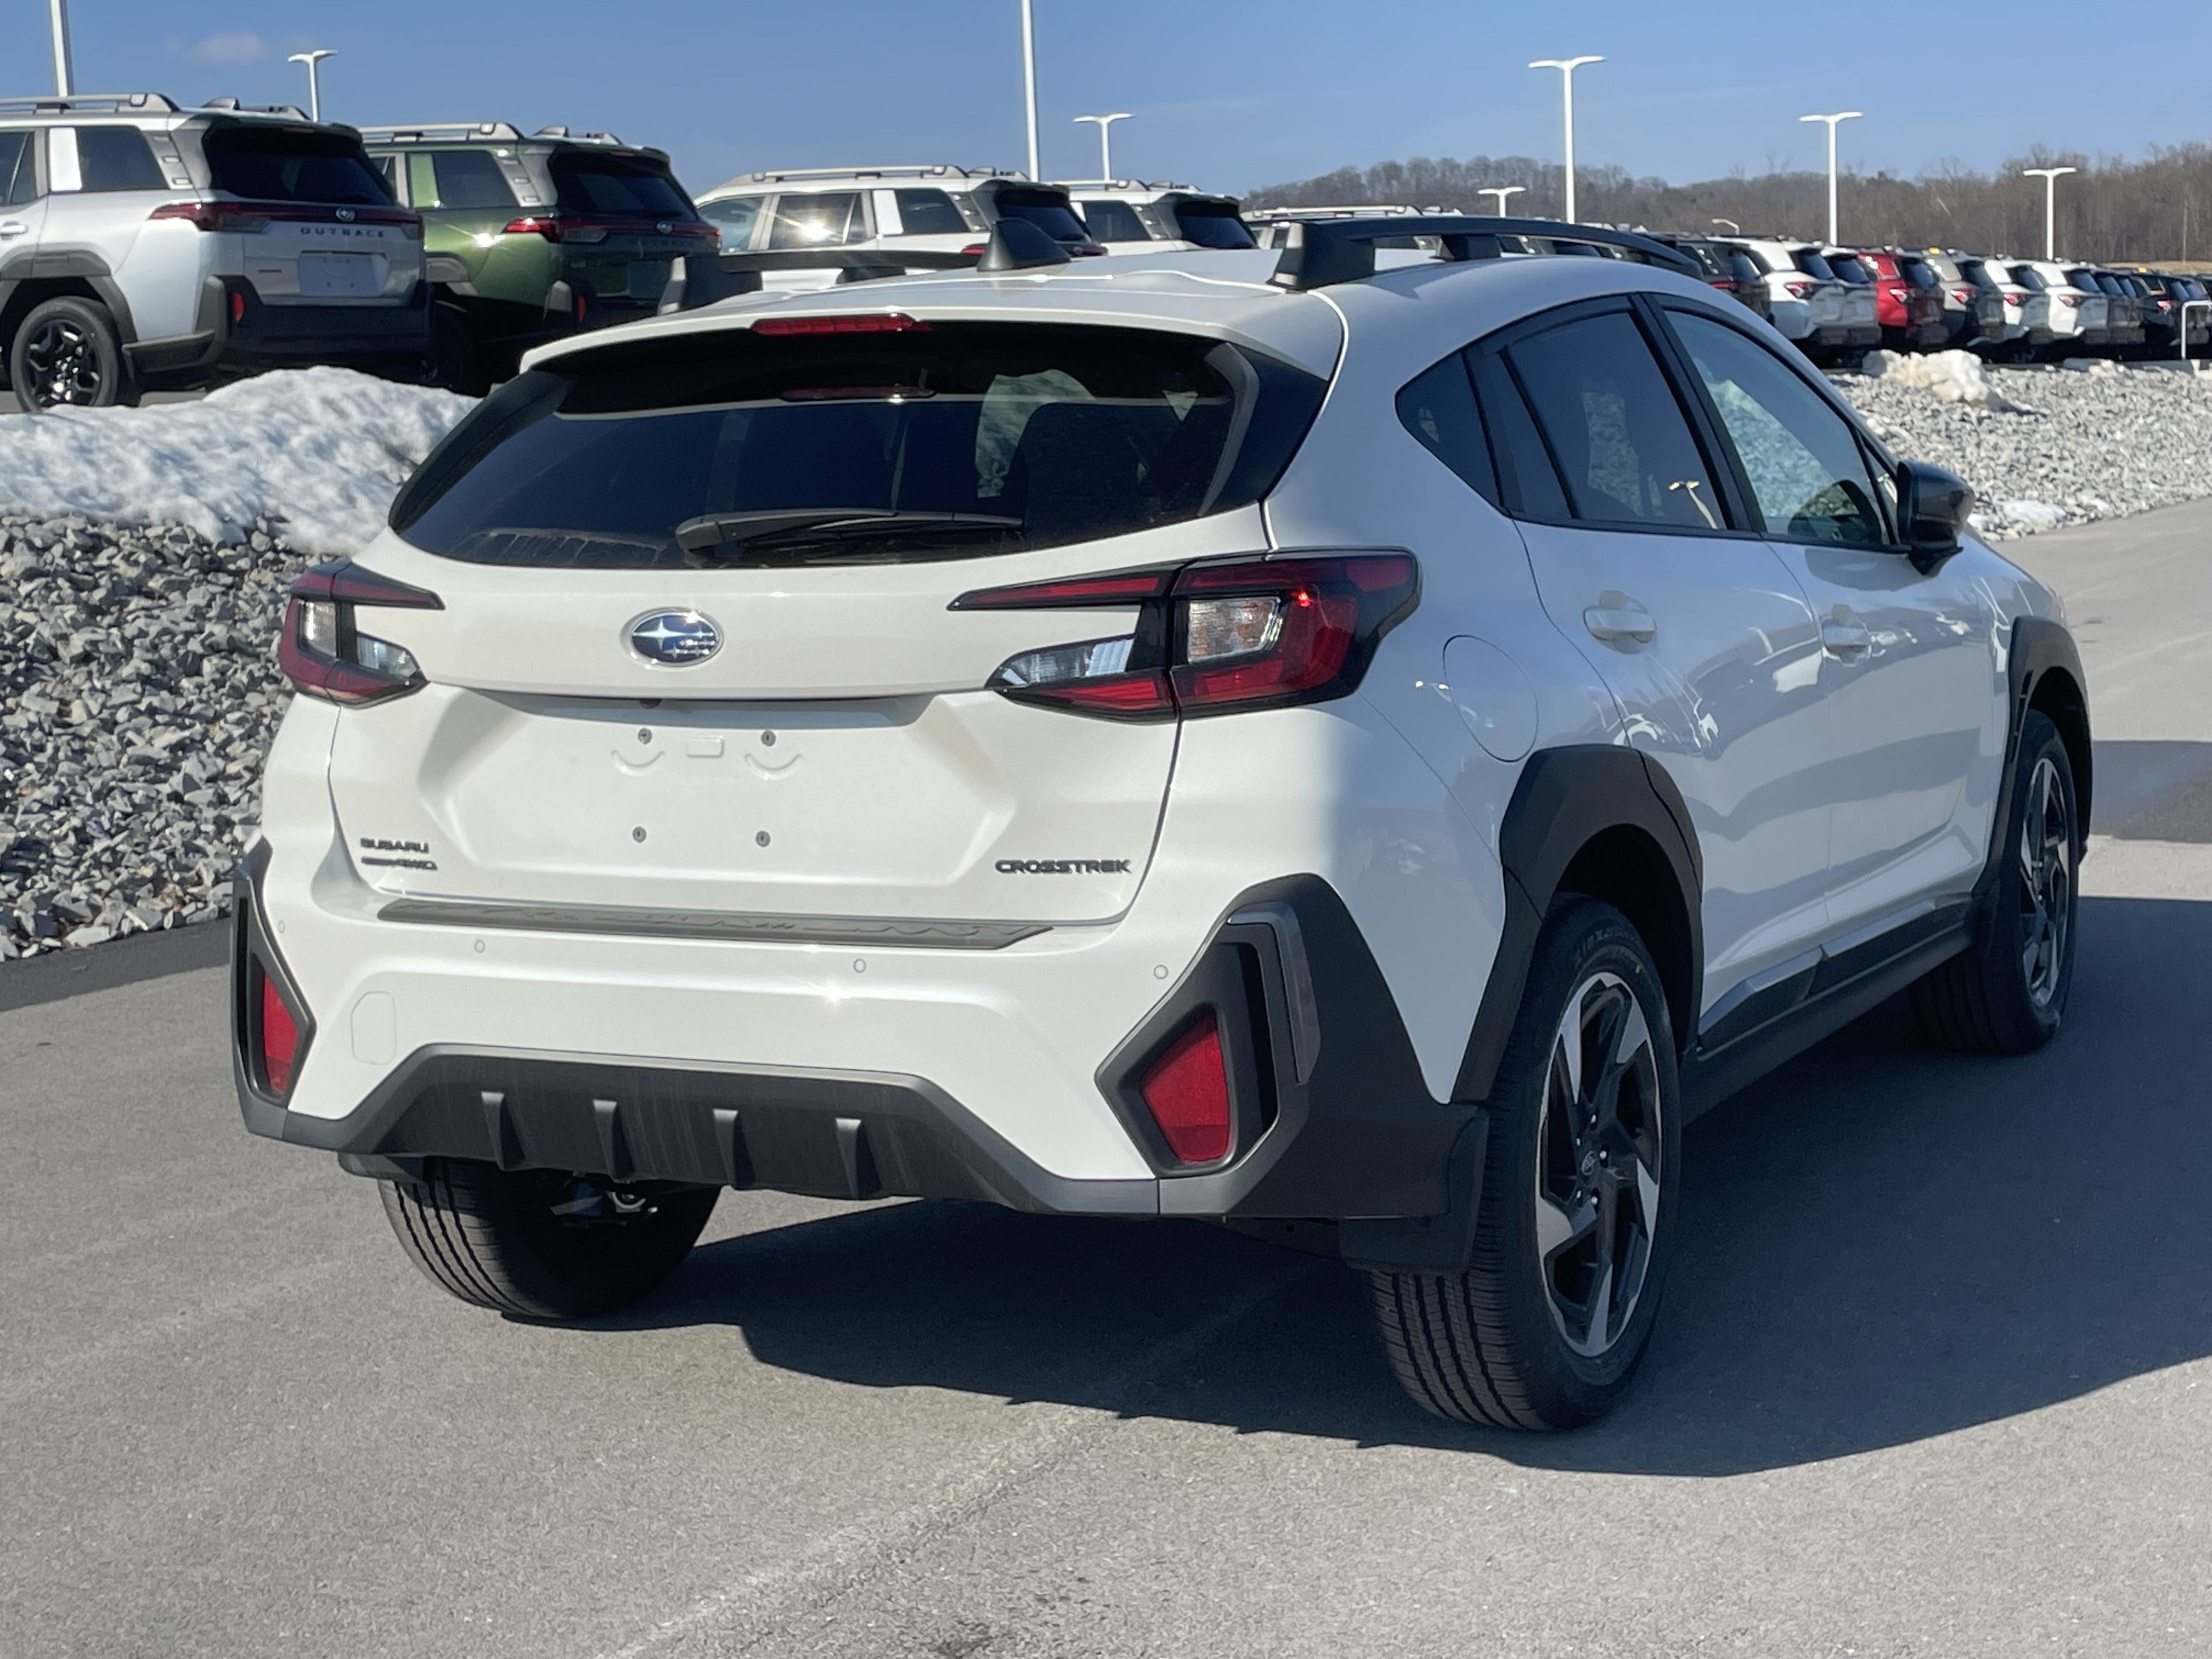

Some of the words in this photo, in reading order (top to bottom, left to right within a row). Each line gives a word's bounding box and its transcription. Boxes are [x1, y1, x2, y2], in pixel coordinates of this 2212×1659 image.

[300, 227, 385, 238] OUTBACK
[360, 838, 430, 854] SUBARU
[995, 859, 1132, 874] CROSSTREK
